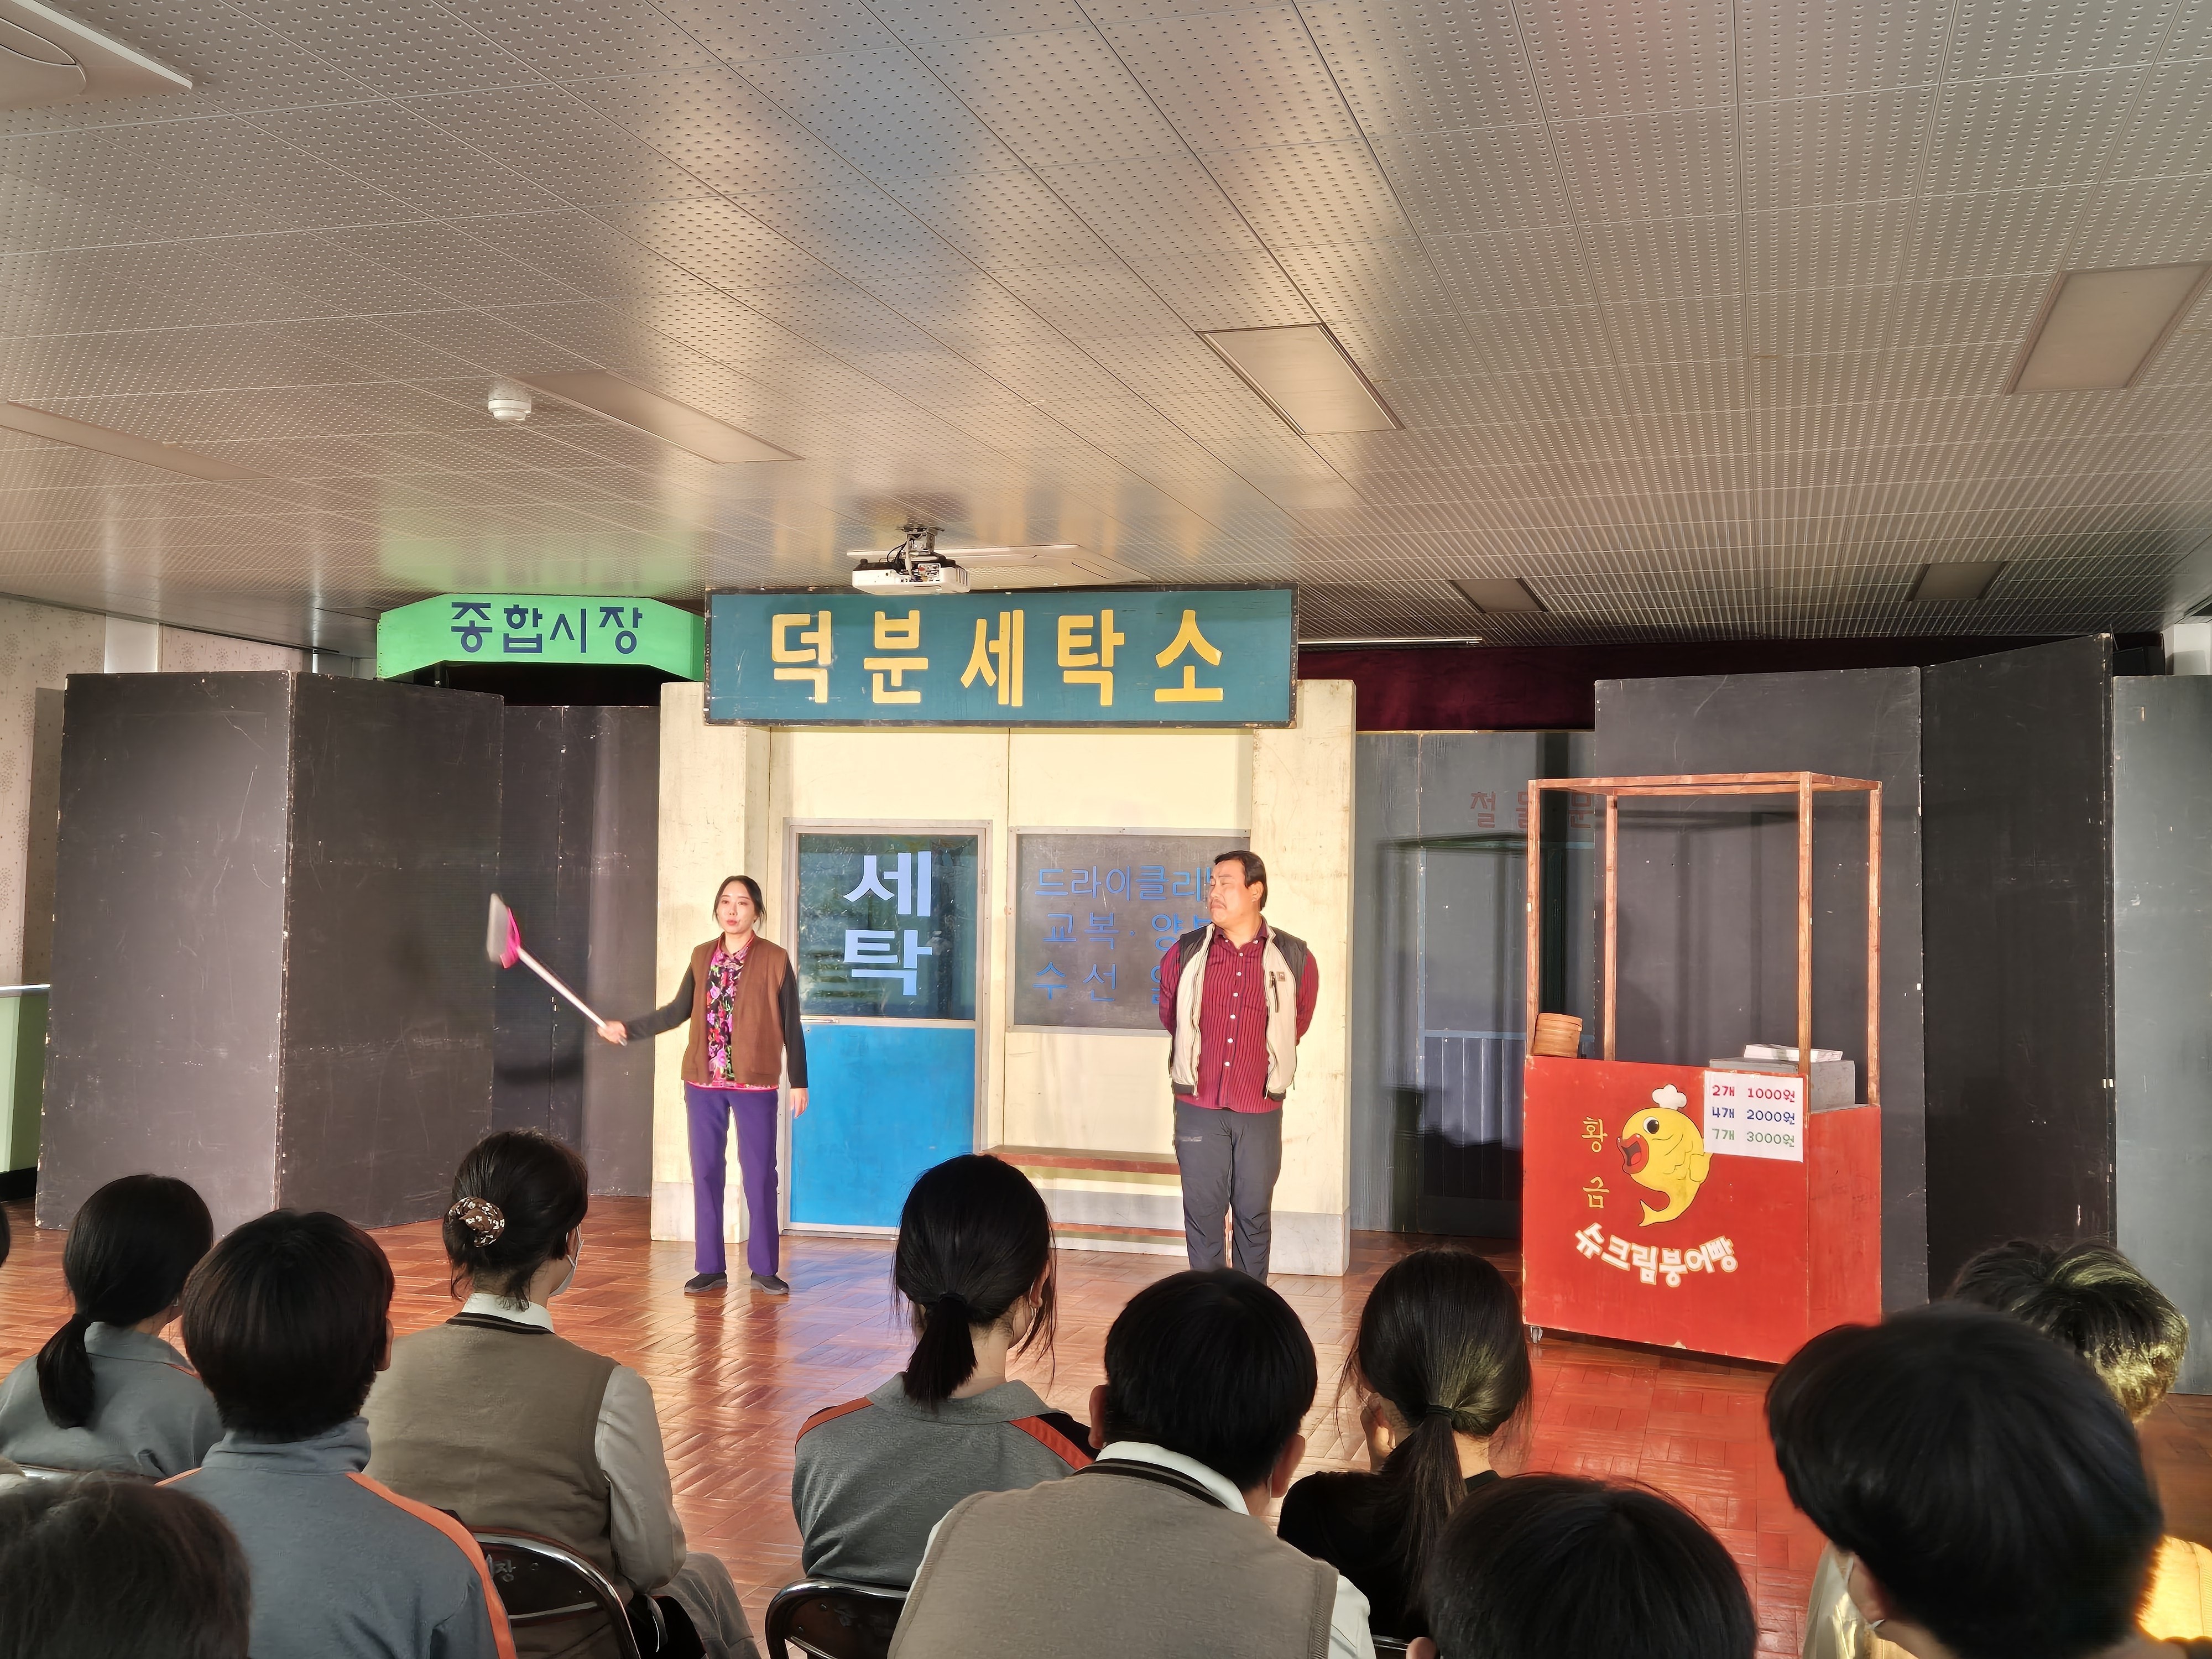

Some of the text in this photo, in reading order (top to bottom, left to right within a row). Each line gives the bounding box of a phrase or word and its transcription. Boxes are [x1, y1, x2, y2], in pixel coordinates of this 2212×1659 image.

[451, 602, 643, 654] 종합시장
[771, 609, 1223, 707] 덕분세탁소
[1034, 865, 1211, 902] 드라이클리
[843, 851, 933, 996] 세탁
[1032, 961, 1117, 1002] 수선
[1712, 1084, 1795, 1103] 2개 1000원
[1712, 1106, 1795, 1125] 4개 2000원
[1712, 1128, 1794, 1147] 7개 3000원
[1581, 1116, 1610, 1209] 황금
